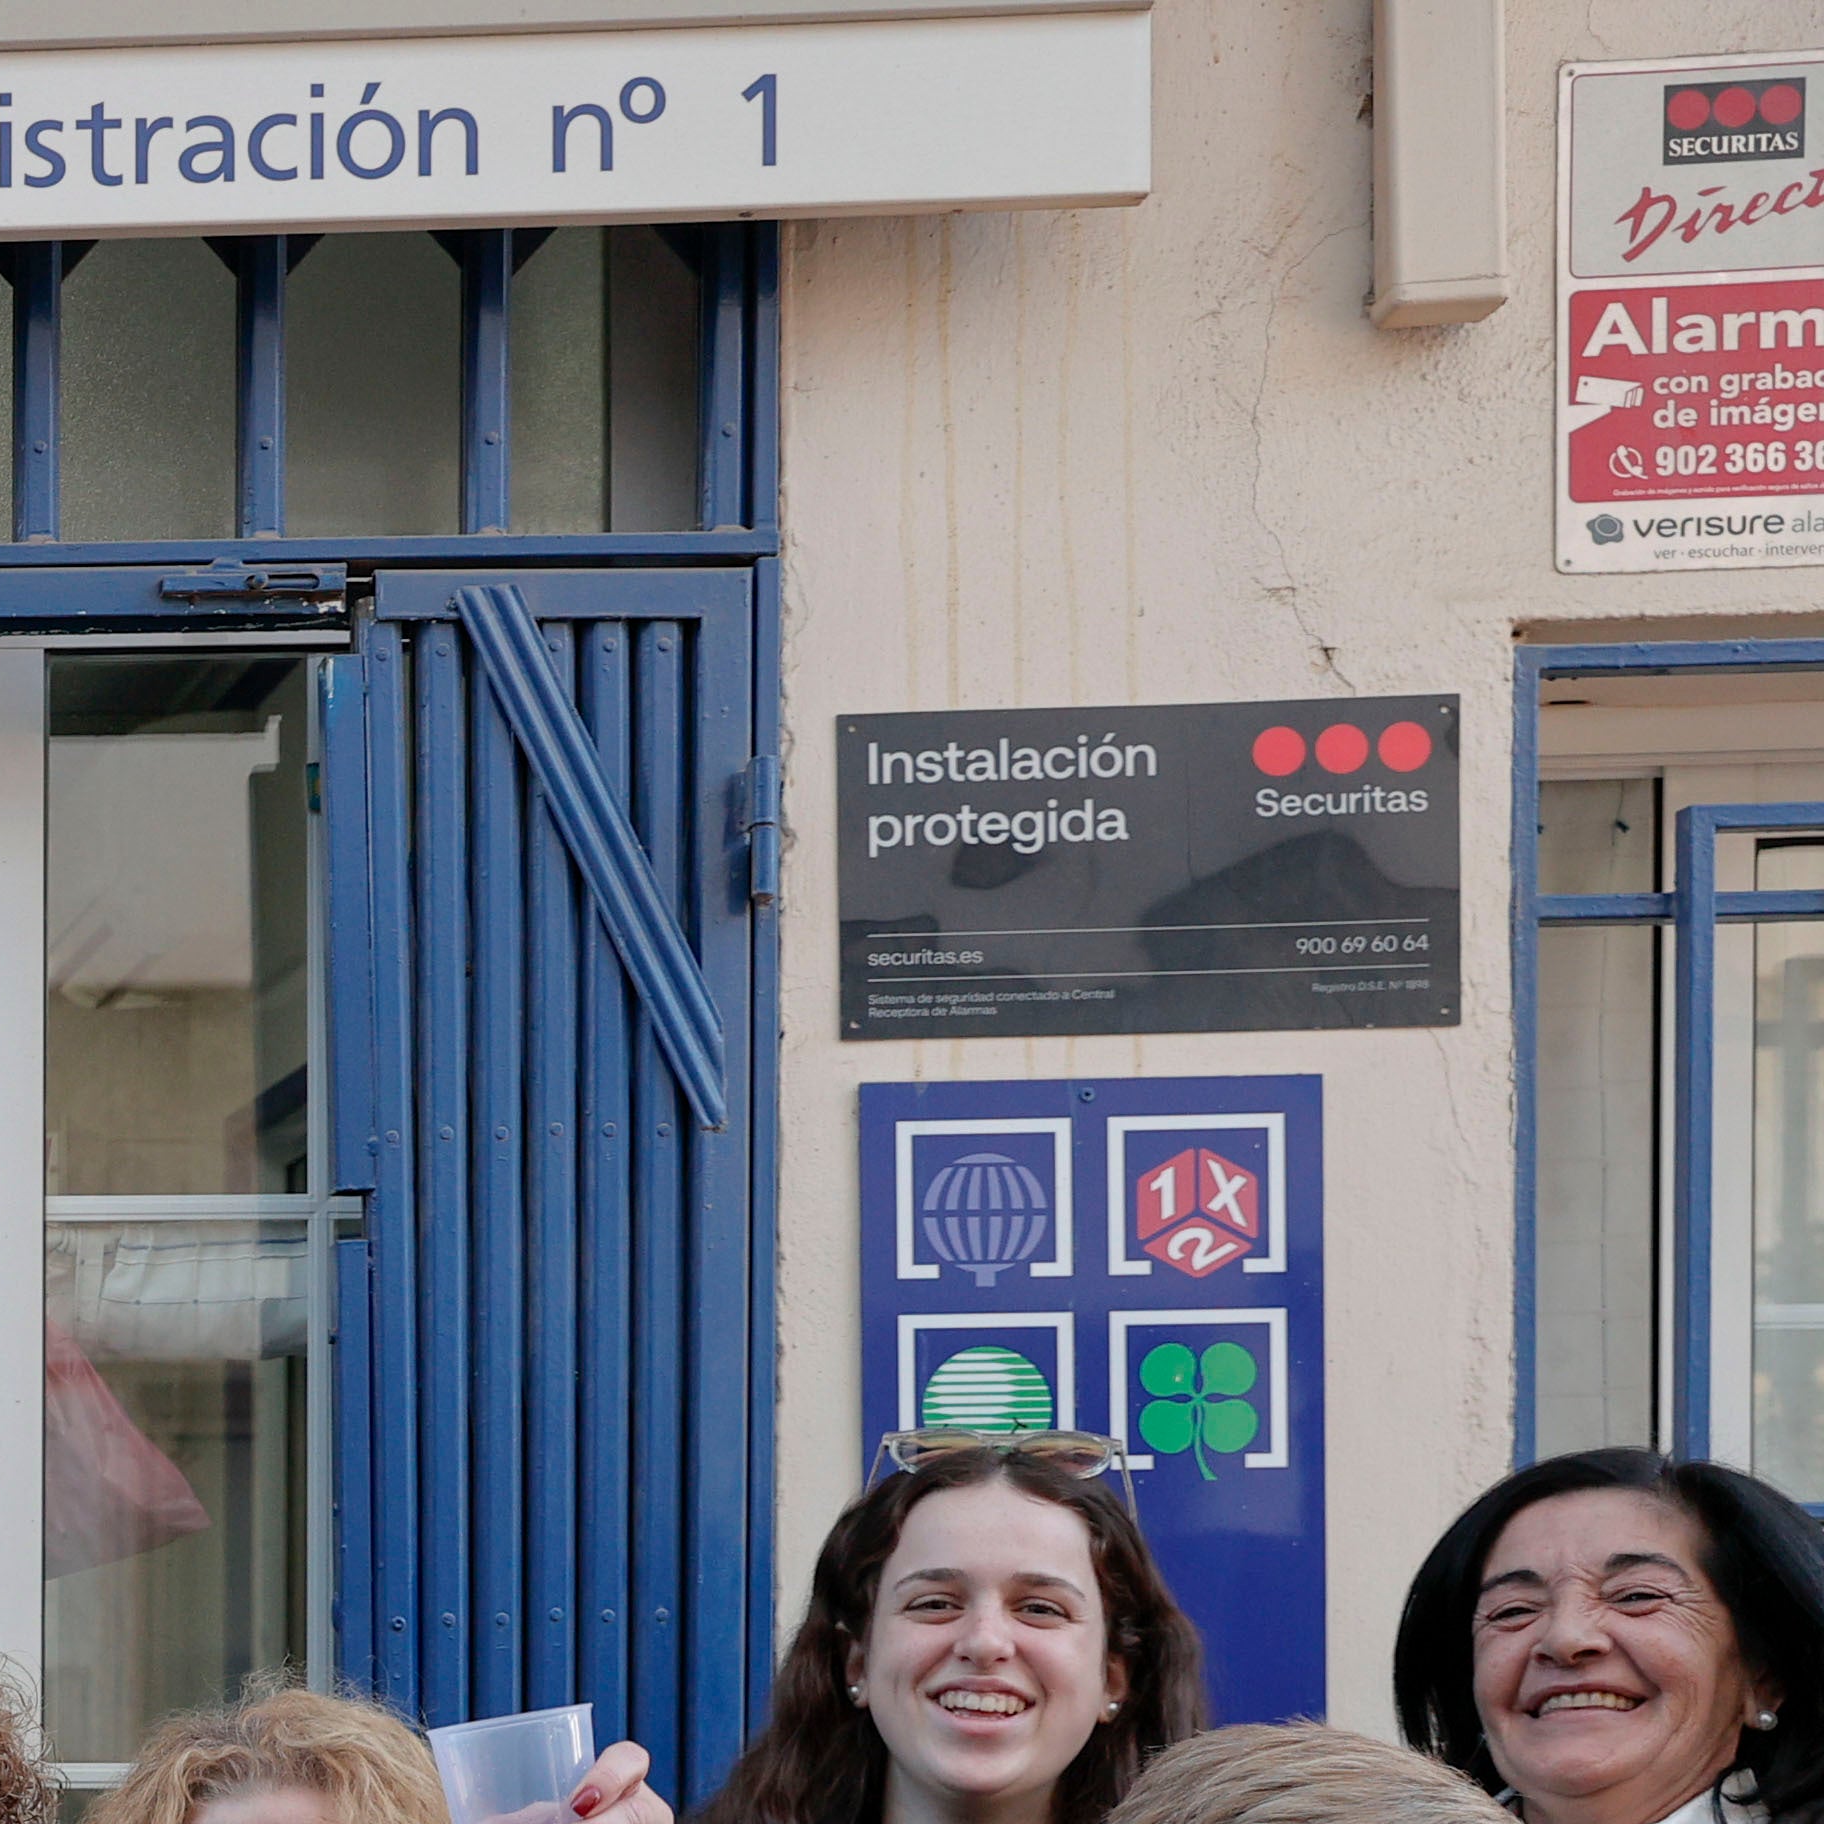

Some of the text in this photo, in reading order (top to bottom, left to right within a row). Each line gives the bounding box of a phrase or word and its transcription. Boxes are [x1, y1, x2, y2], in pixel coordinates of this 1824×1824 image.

[551, 76, 666, 174] nº
[740, 74, 780, 168] 1
[1669, 132, 1799, 157] SECURITAS
[1581, 297, 1824, 357] Alarm
[1653, 375, 1709, 395] con
[1653, 396, 1824, 432] de imáge
[1655, 444, 1718, 477] 902
[1724, 441, 1787, 474] 366
[1633, 514, 1785, 538] verisure
[1654, 549, 1678, 560] ver
[1688, 544, 1753, 559] escuchar
[867, 733, 1158, 786] Instalación
[1255, 783, 1430, 819] Securitas
[867, 799, 1130, 859] protegida
[867, 948, 985, 967] securitas.es
[1295, 933, 1430, 955] 900 69 60 64
[917, 992, 933, 1005] de
[931, 1005, 948, 1017] de
[1150, 1166, 1176, 1220] 1
[1167, 1227, 1238, 1270] 2
